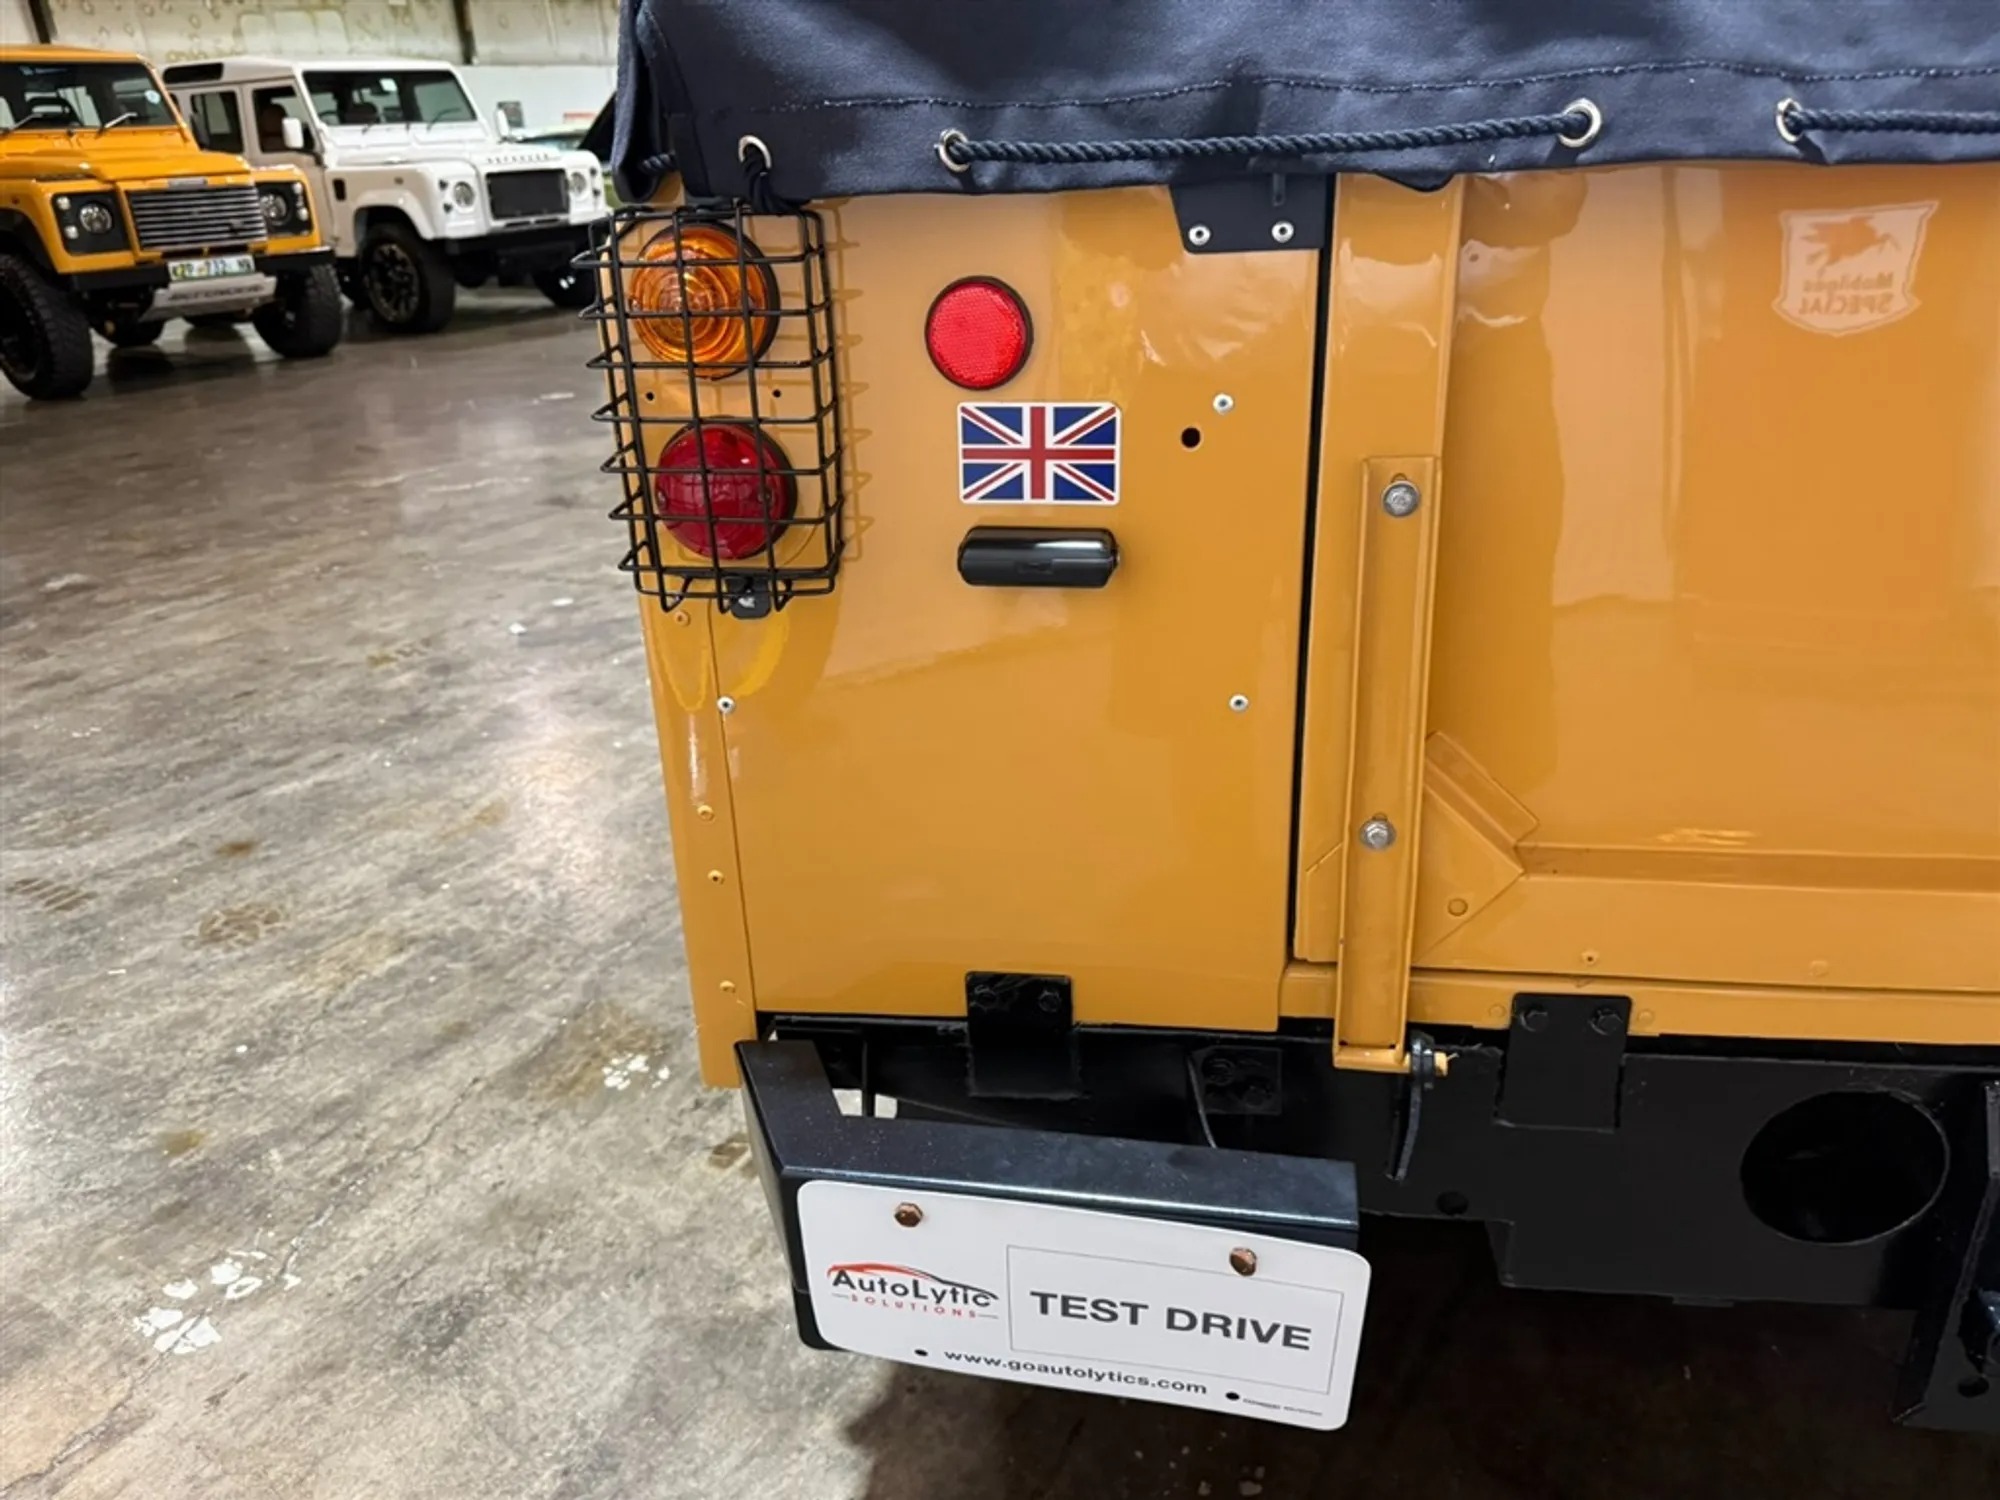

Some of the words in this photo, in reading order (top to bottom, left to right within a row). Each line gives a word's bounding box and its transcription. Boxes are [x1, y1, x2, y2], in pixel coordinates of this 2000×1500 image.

[832, 1269, 991, 1307] AutoLytic
[851, 1294, 976, 1318] SOLUTIONS
[1030, 1291, 1149, 1326] TEST
[1166, 1307, 1312, 1350] DRIVE
[944, 1350, 1208, 1395] www.goautolytics.com
